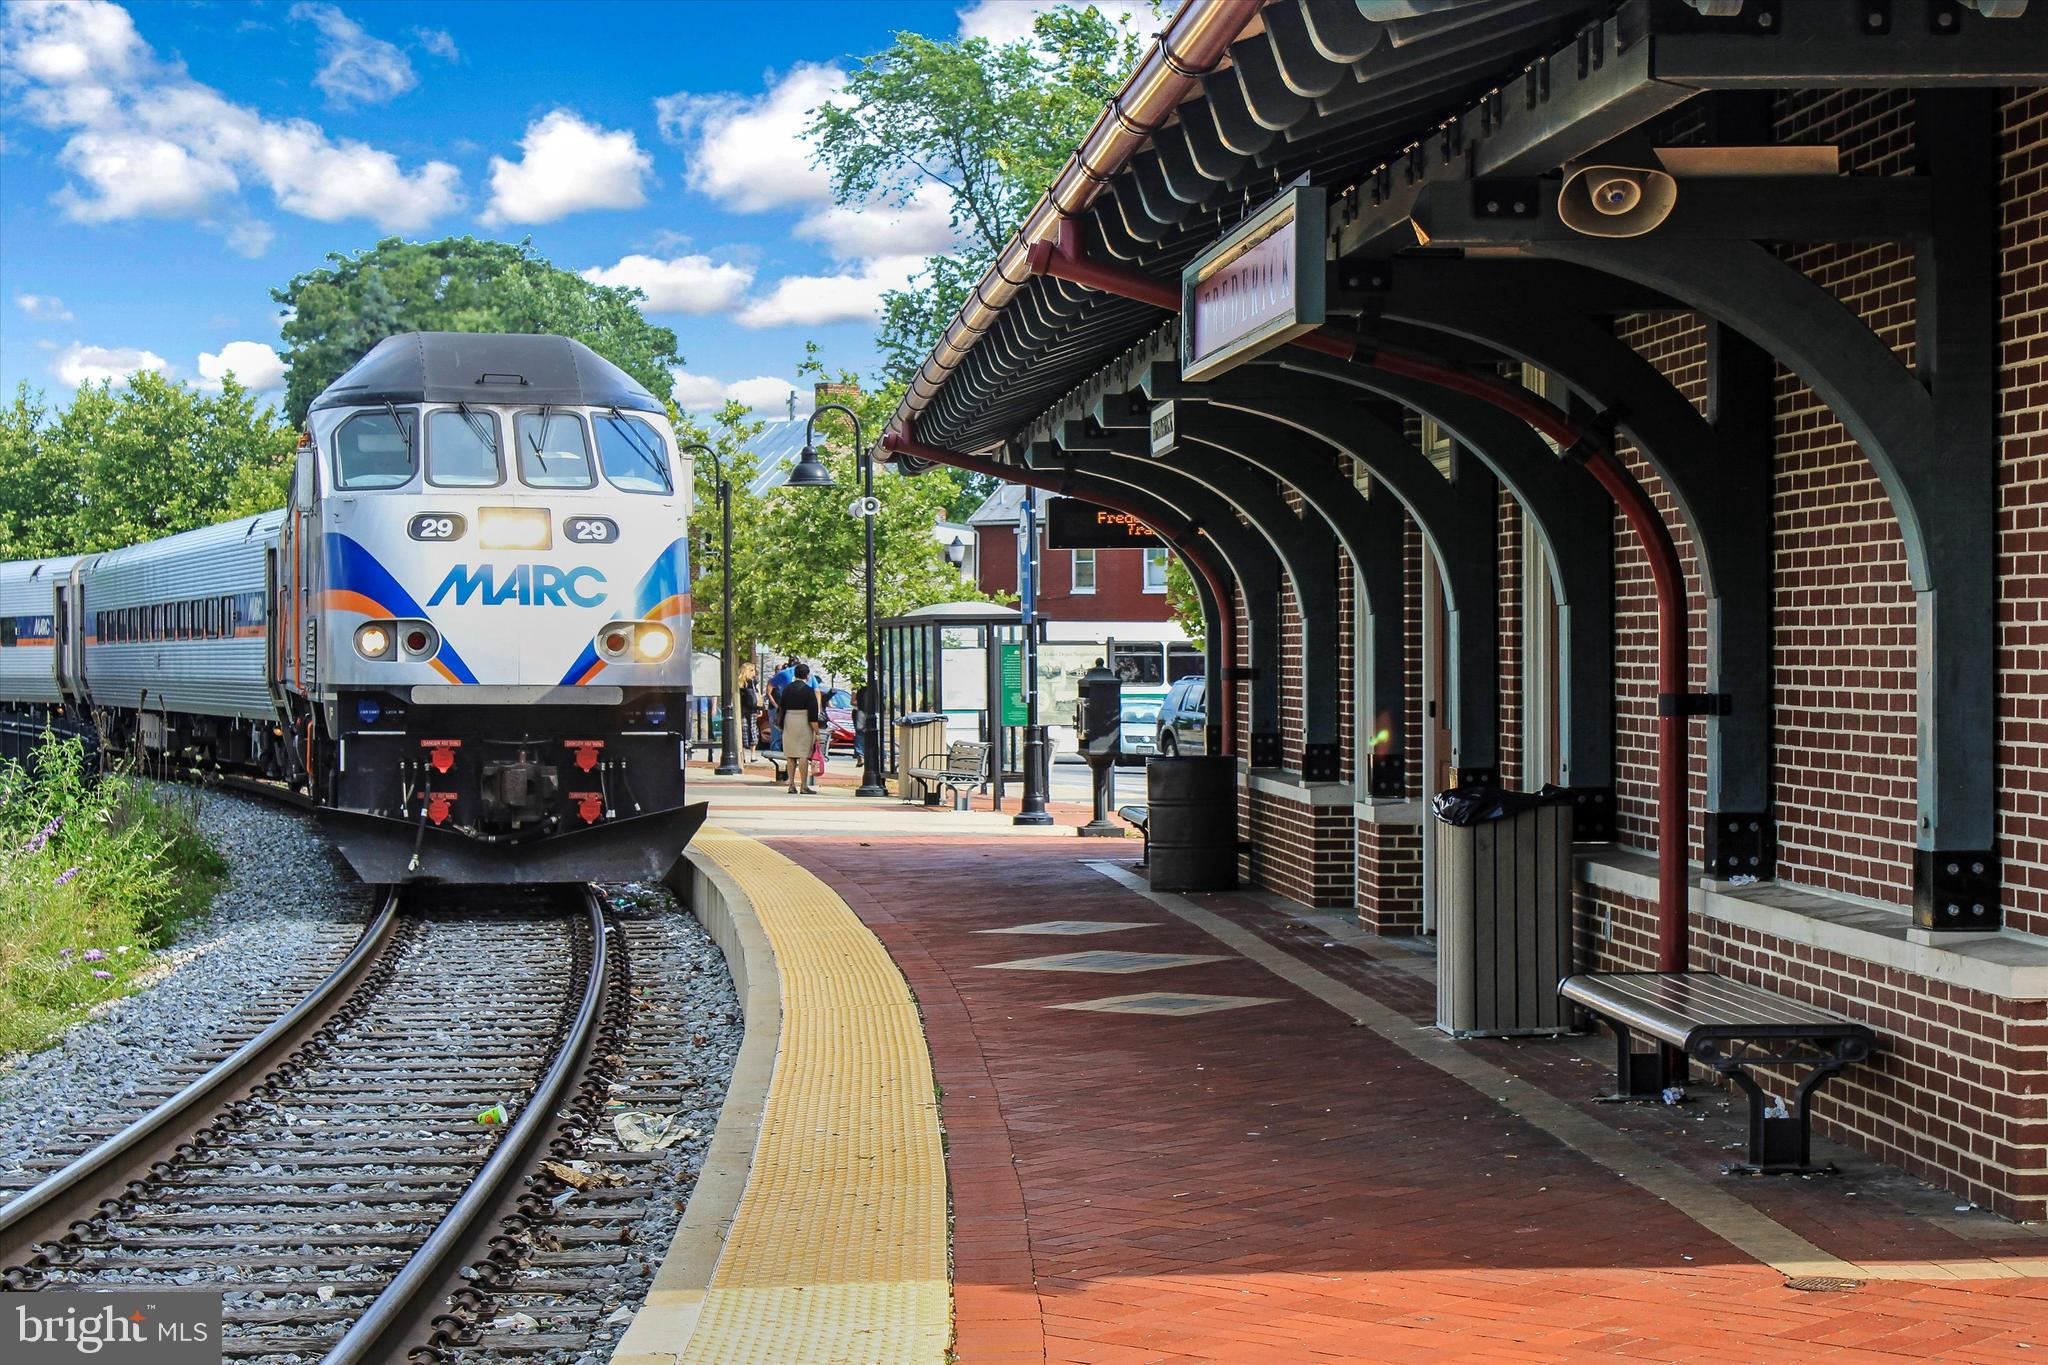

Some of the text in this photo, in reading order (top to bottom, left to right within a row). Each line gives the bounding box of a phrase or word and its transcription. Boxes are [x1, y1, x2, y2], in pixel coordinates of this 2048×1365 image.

[1203, 239, 1291, 337] FREDERICK
[420, 518, 454, 538] 29
[575, 521, 608, 540] 29
[1127, 523, 1156, 536] Tra
[426, 563, 609, 609] MARC
